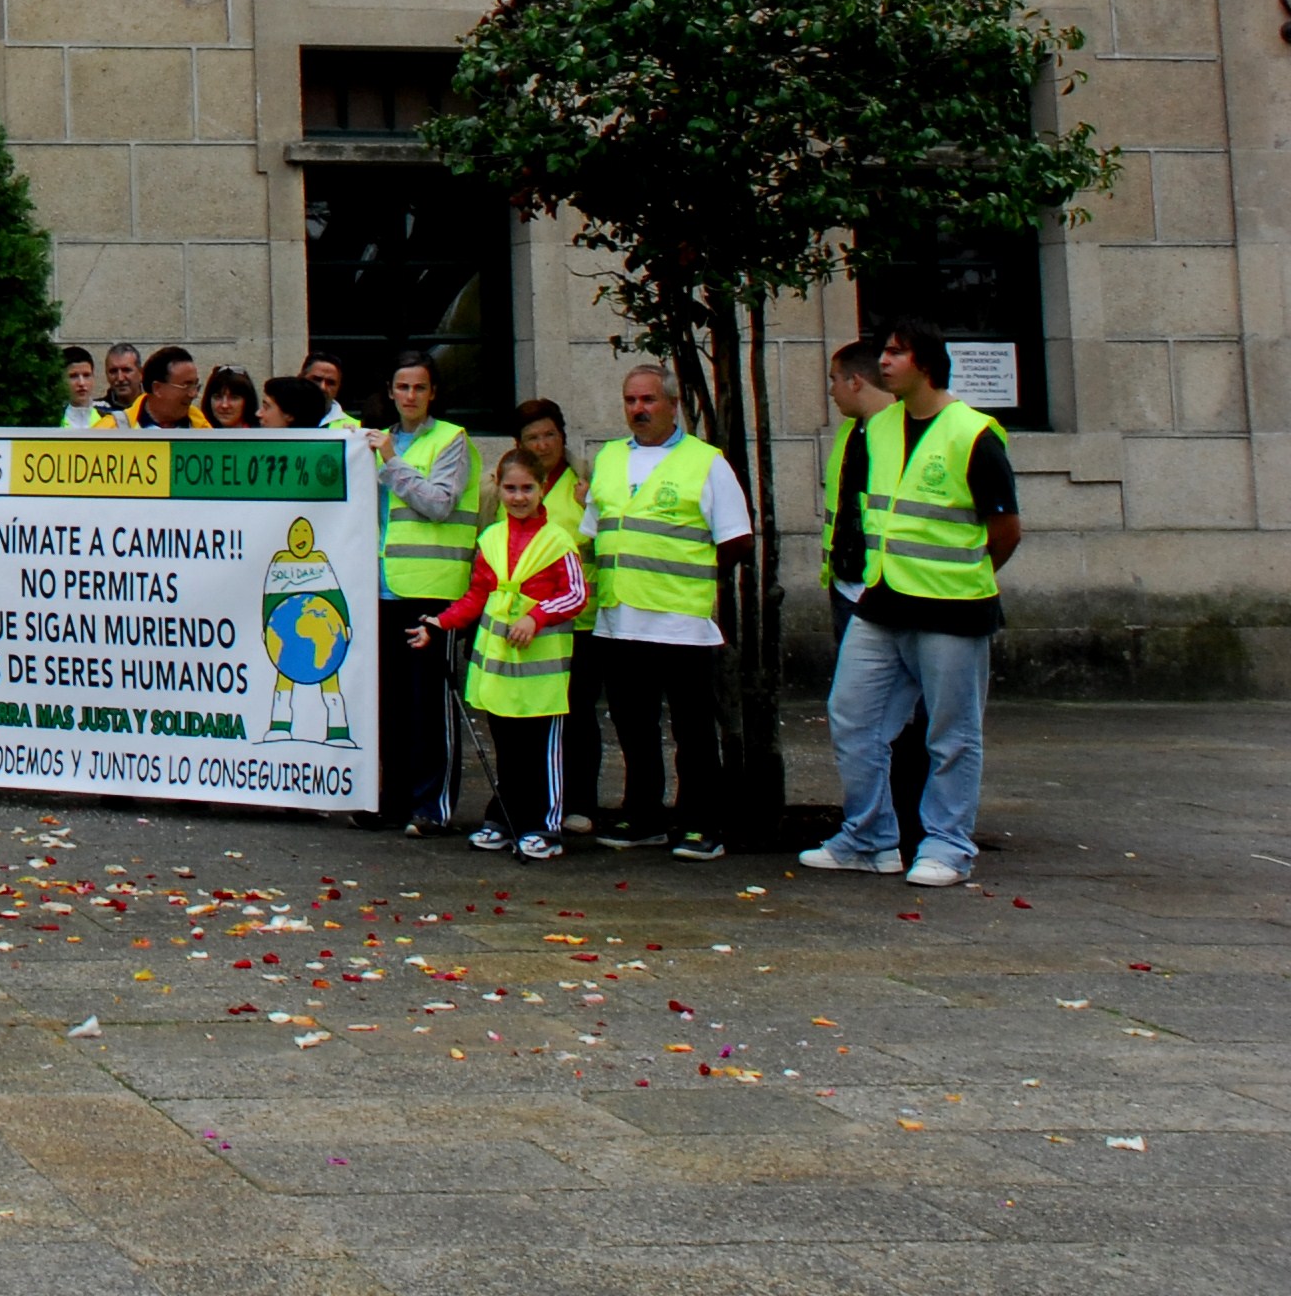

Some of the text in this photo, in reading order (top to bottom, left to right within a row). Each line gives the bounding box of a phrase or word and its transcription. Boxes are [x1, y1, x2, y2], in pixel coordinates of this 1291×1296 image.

[23, 453, 158, 485] SOLIDARIAS
[174, 454, 214, 486] POR
[222, 455, 241, 486] EL
[295, 456, 309, 487] %
[88, 527, 105, 557] A
[112, 526, 243, 560] CAMINAR!!
[21, 568, 178, 603] NO PERMITAS
[25, 611, 96, 644] SIGAN
[104, 614, 236, 649] MURIENDO
[8, 654, 38, 684] DE
[45, 655, 114, 688] SERES
[121, 659, 248, 694] HUMANOS
[35, 704, 75, 731] MAS
[77, 706, 133, 734] JUSTA
[133, 709, 147, 734] Y
[150, 708, 247, 740] SOLIDARIA
[71, 749, 82, 777] Y
[89, 750, 162, 783] JUNTOS
[169, 755, 191, 785] LO
[198, 757, 353, 796] CONSEGUIREMOS
